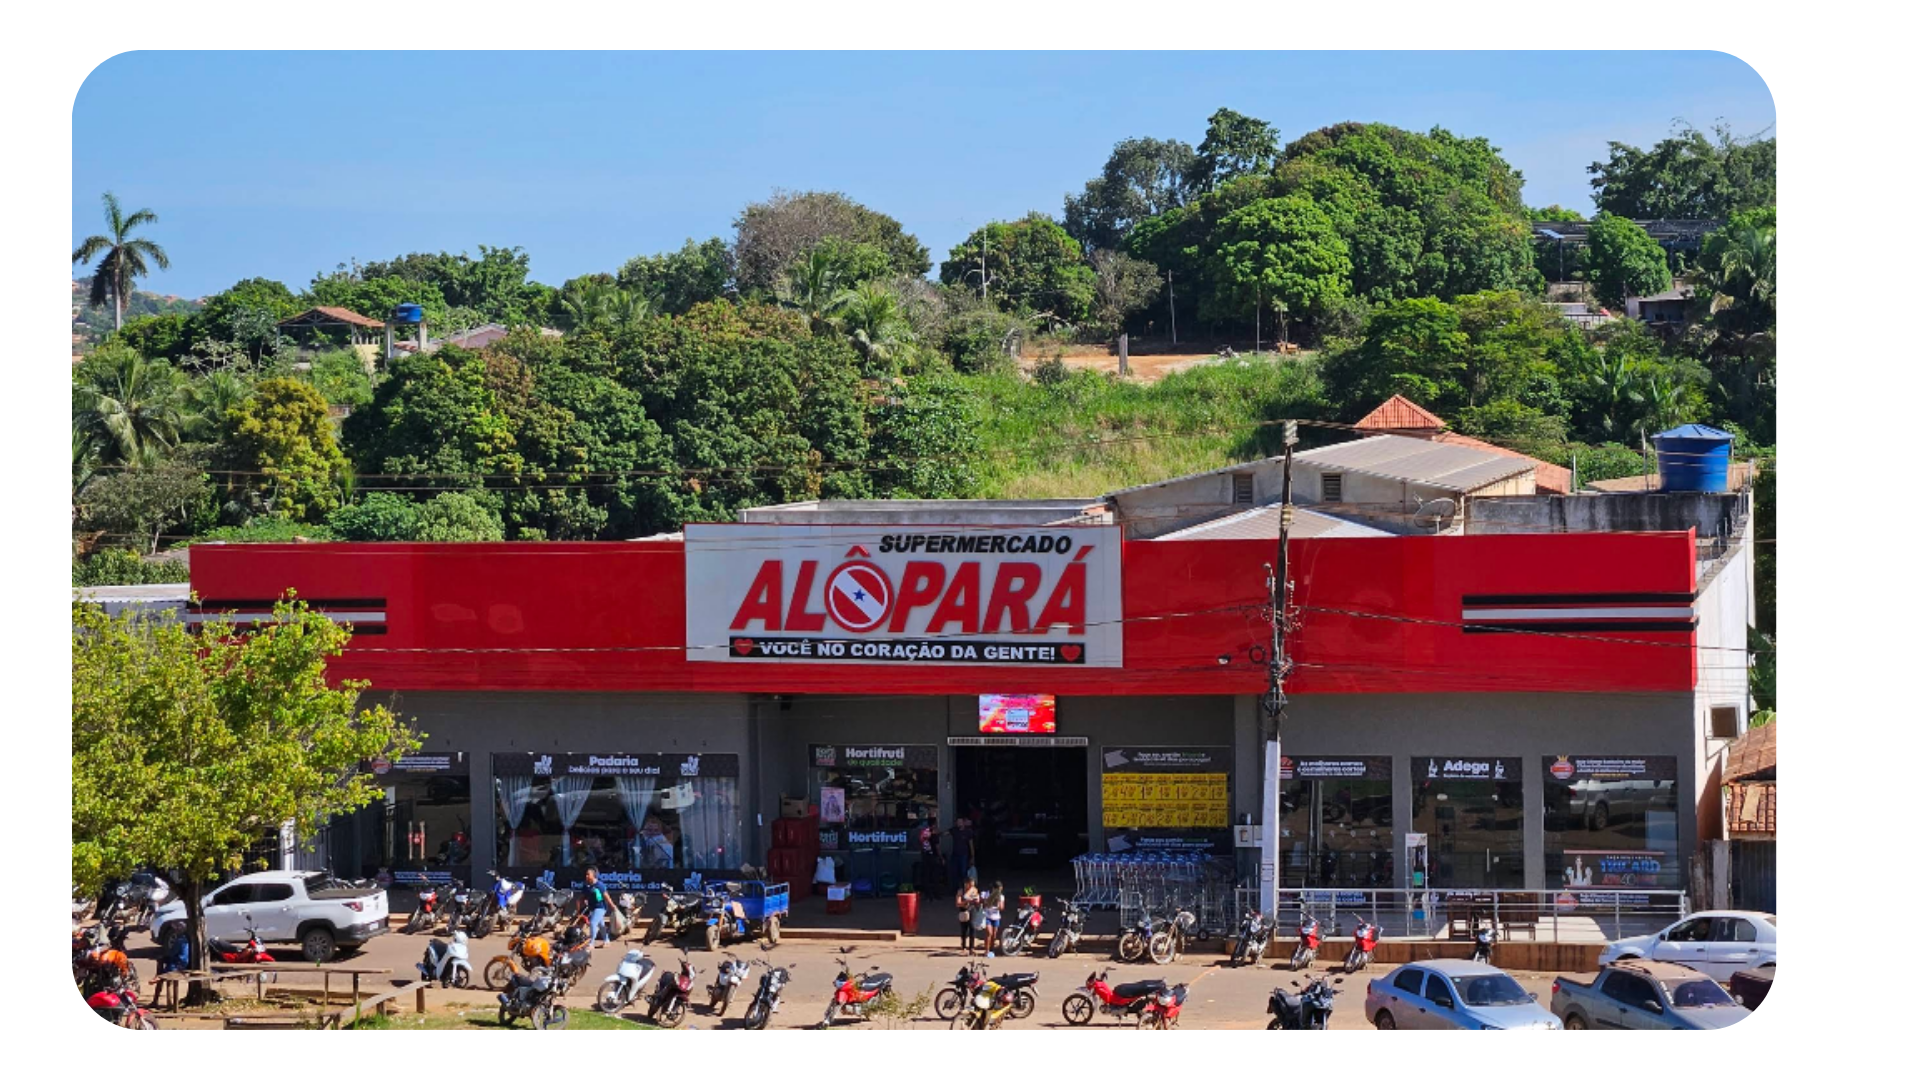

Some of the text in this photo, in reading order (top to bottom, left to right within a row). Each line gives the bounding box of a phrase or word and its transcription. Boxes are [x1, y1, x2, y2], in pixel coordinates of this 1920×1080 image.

[878, 534, 1073, 554] SUPERMERCADO
[760, 638, 1056, 662] VOCÊ NO CORAÇÃO DA GENTE!
[845, 747, 905, 759] Hortifruti
[589, 755, 639, 766] Padaria
[1443, 759, 1490, 774] Adega
[848, 831, 907, 843] Hortifruti
[598, 870, 642, 882] adaria
